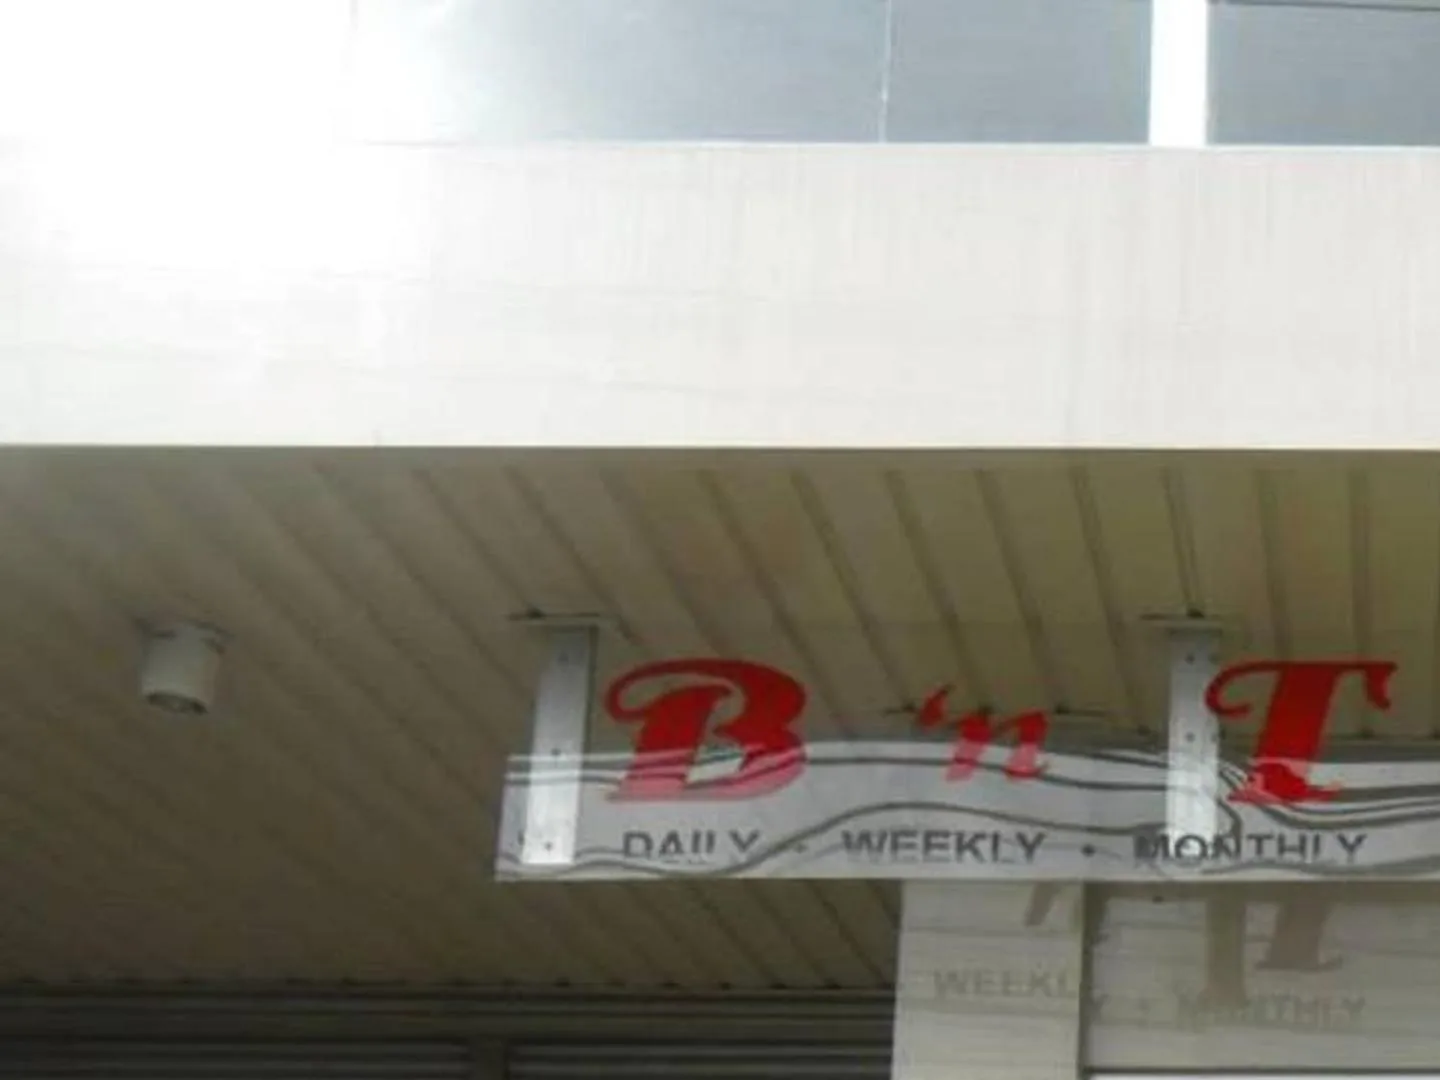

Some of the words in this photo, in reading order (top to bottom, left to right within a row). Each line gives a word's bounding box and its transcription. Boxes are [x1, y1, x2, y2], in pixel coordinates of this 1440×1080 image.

[603, 658, 807, 802] B
[1205, 660, 1397, 805] T
[622, 829, 761, 862] DAILY
[842, 830, 1047, 865] WEEKLY
[1133, 832, 1368, 868] MONTHLY
